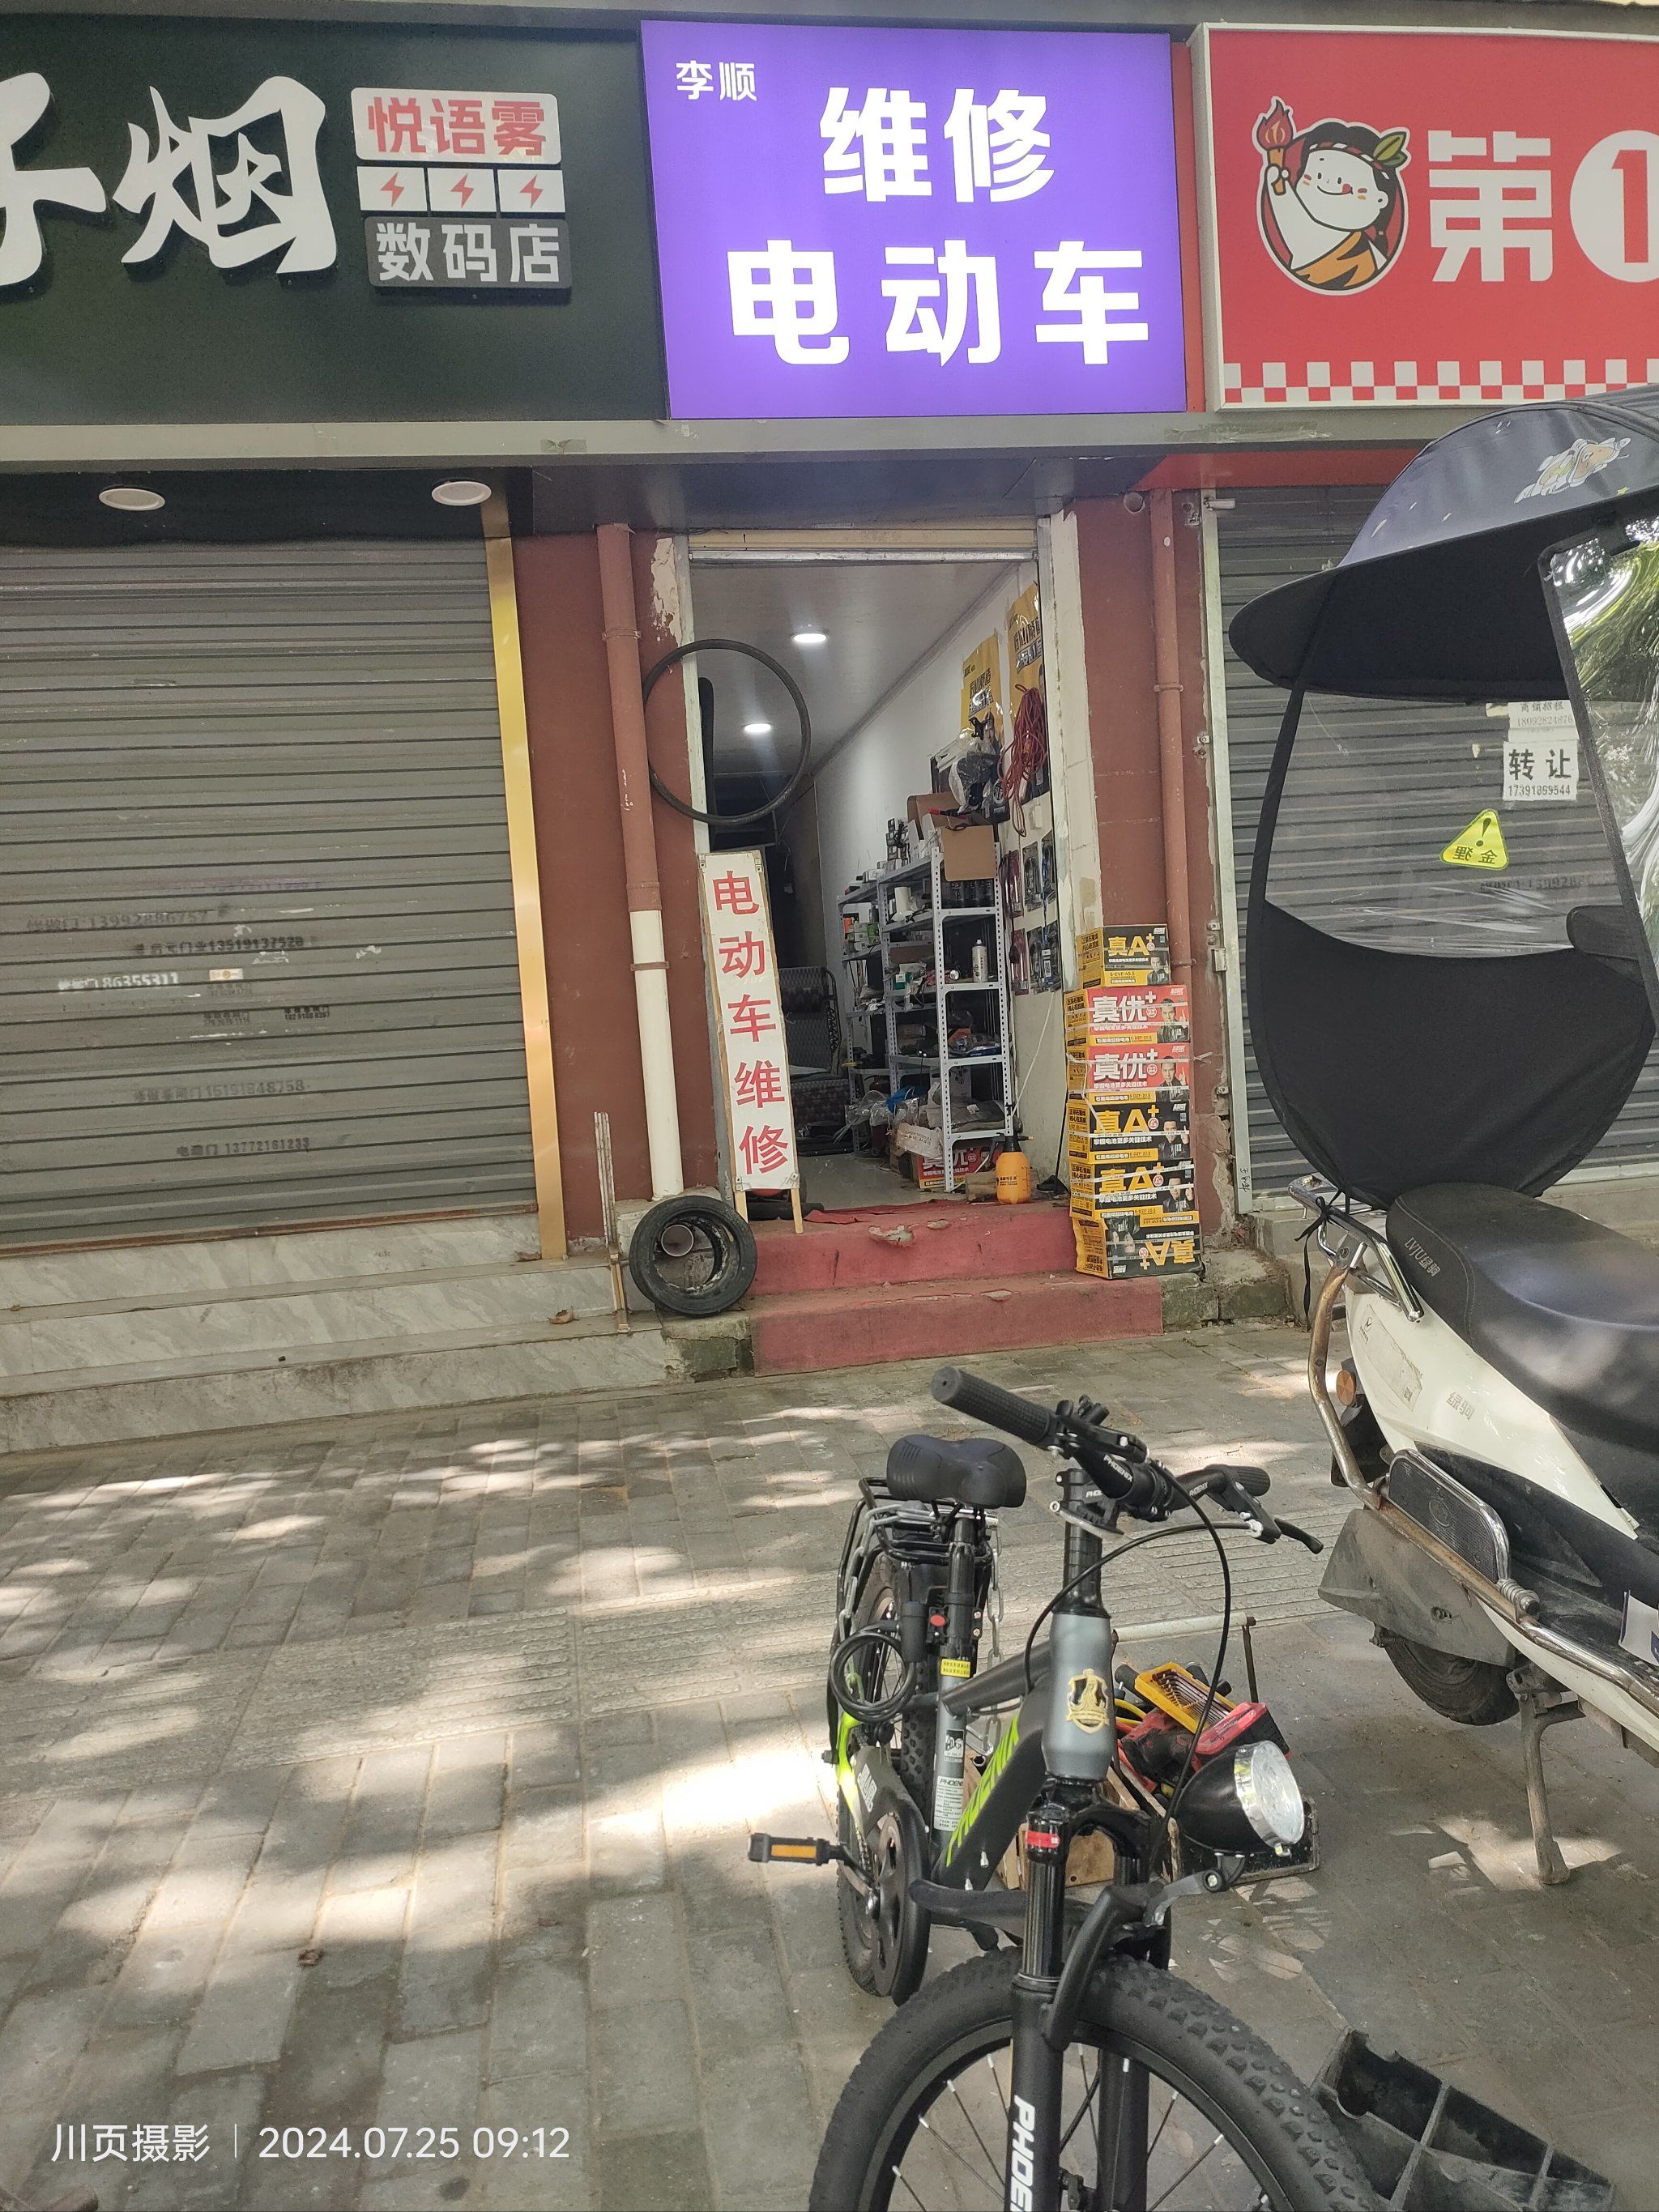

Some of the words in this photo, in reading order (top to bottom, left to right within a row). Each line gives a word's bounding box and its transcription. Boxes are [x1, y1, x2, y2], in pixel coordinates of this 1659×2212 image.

[676, 60, 757, 101] 李顺
[367, 96, 547, 156] 悦语雾
[819, 87, 1055, 202] 维修
[376, 222, 561, 283] 数码店
[727, 239, 1149, 367] 电动车
[1509, 748, 1572, 781] 转让
[712, 870, 789, 1174] 电动车维修
[1103, 1455, 1133, 1482] PHOENIX
